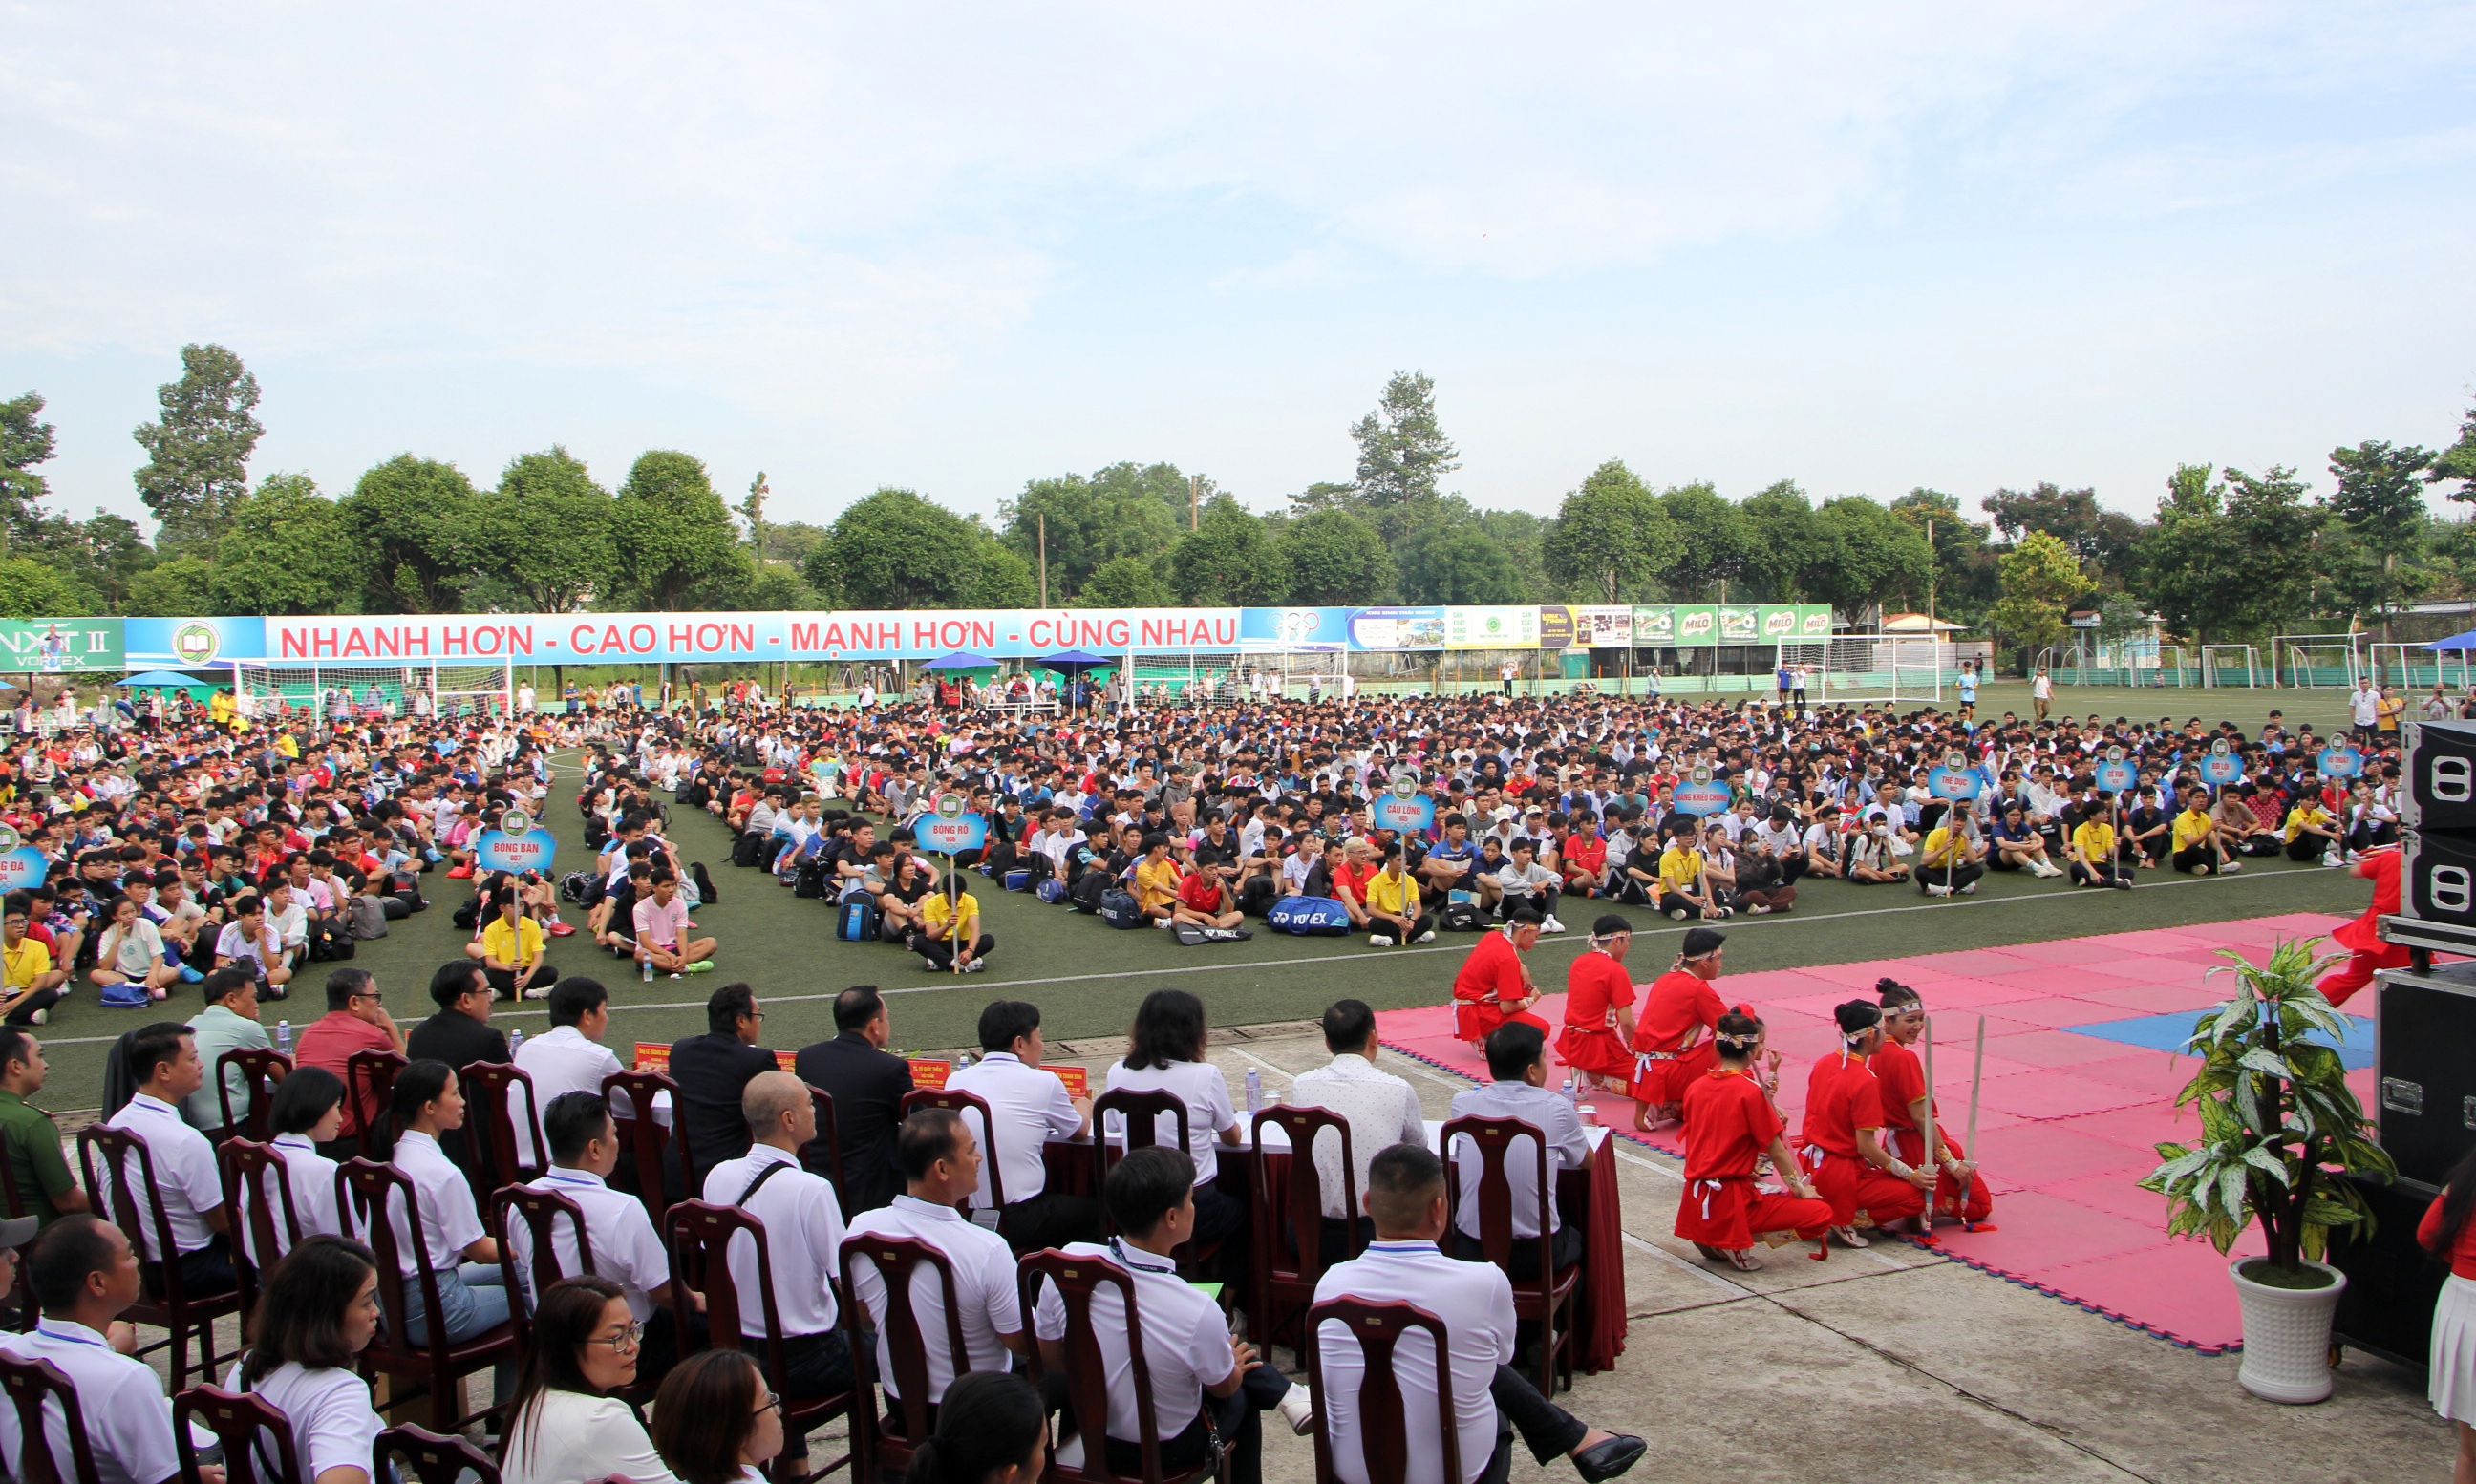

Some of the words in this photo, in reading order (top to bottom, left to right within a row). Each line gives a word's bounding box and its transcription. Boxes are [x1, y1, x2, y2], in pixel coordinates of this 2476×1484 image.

[1685, 618, 1710, 630] MILO
[1768, 617, 1793, 629] MILO
[1806, 619, 1826, 629] MILO
[281, 626, 429, 658] NHANH
[442, 625, 533, 656] HƠN
[570, 624, 658, 654] CAO
[668, 623, 754, 653] HƠN
[791, 622, 901, 658] MẠNH
[914, 621, 994, 649] HƠN
[1029, 612, 1131, 647] CÙNG
[1142, 618, 1236, 646] NHAU
[15, 655, 87, 667] VORTEX
[1402, 804, 1421, 816] LÔNG
[932, 823, 955, 835] BÓNG
[957, 822, 969, 835] RỔ
[494, 841, 518, 853] BÓNG
[521, 842, 539, 853] BÀN
[11, 859, 25, 871] ĐÁ
